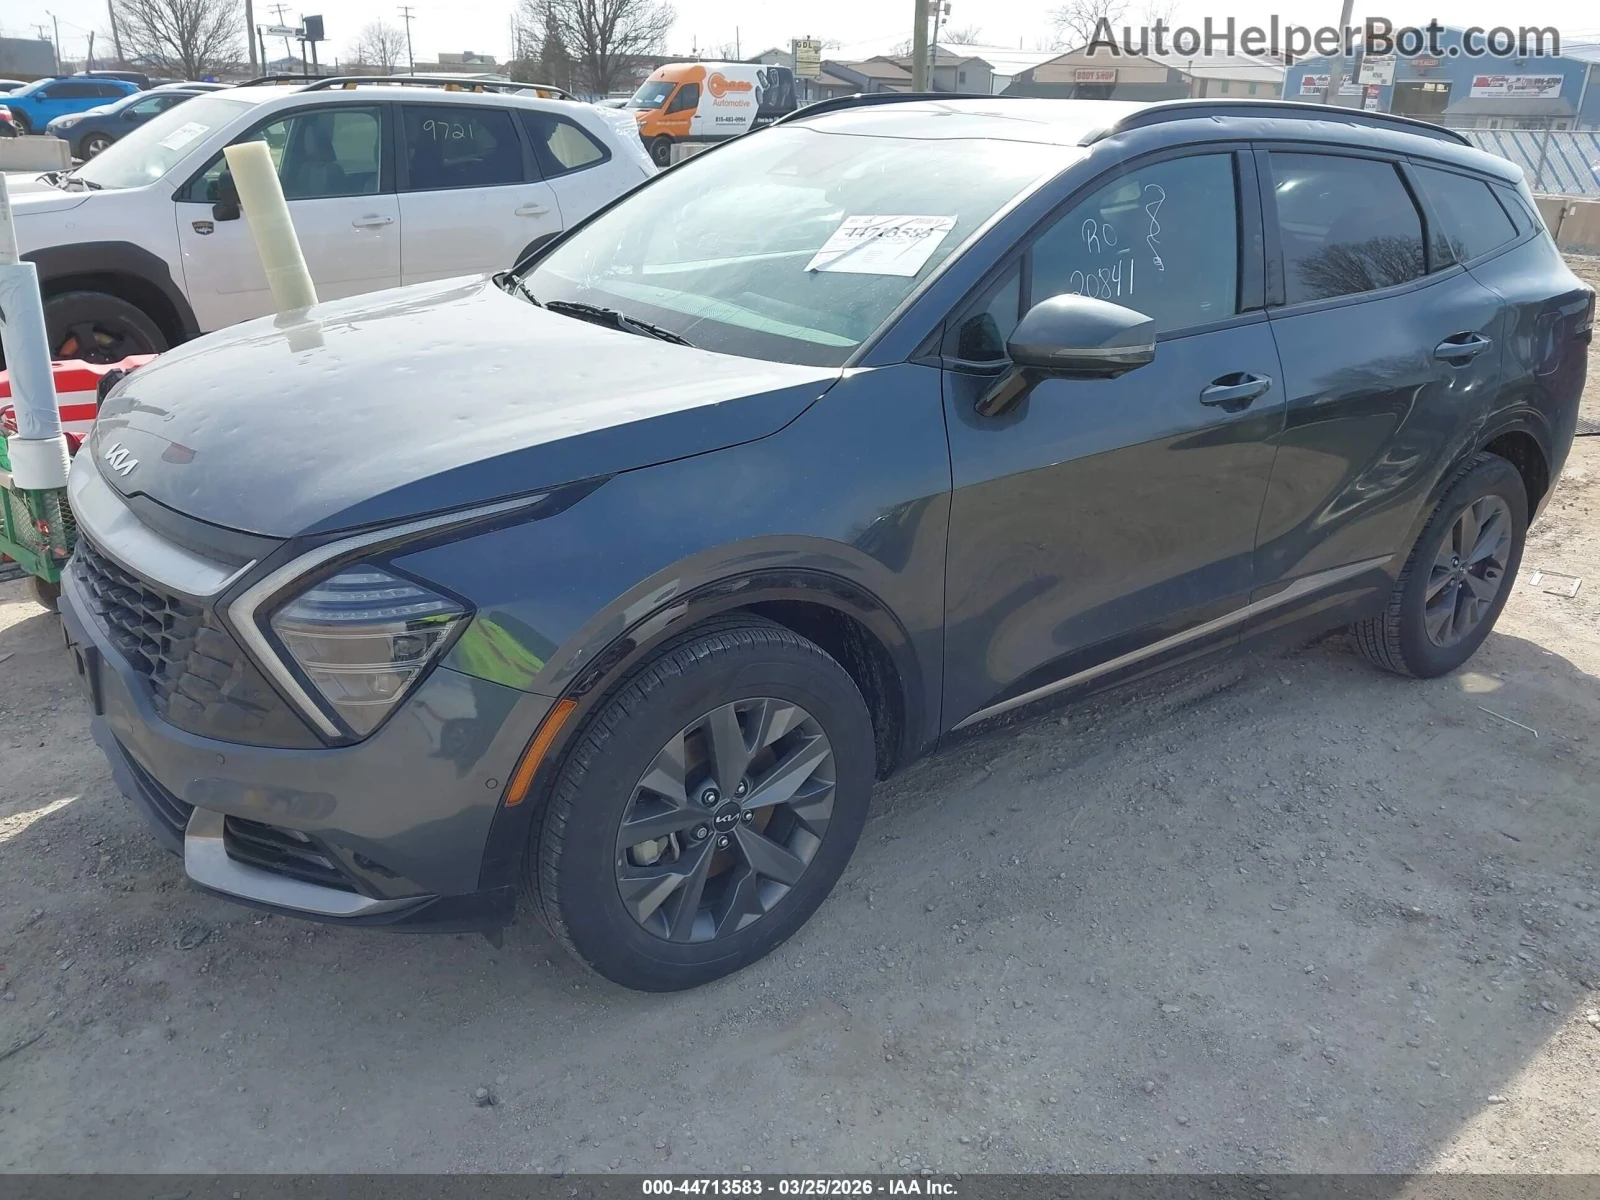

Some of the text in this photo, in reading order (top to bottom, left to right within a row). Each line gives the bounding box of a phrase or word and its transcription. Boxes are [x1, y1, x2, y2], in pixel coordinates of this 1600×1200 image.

[1077, 72, 1114, 80] BODY SHOP
[712, 99, 751, 107] Automotive
[423, 119, 473, 141] 9721
[1070, 258, 1134, 300] 20841
